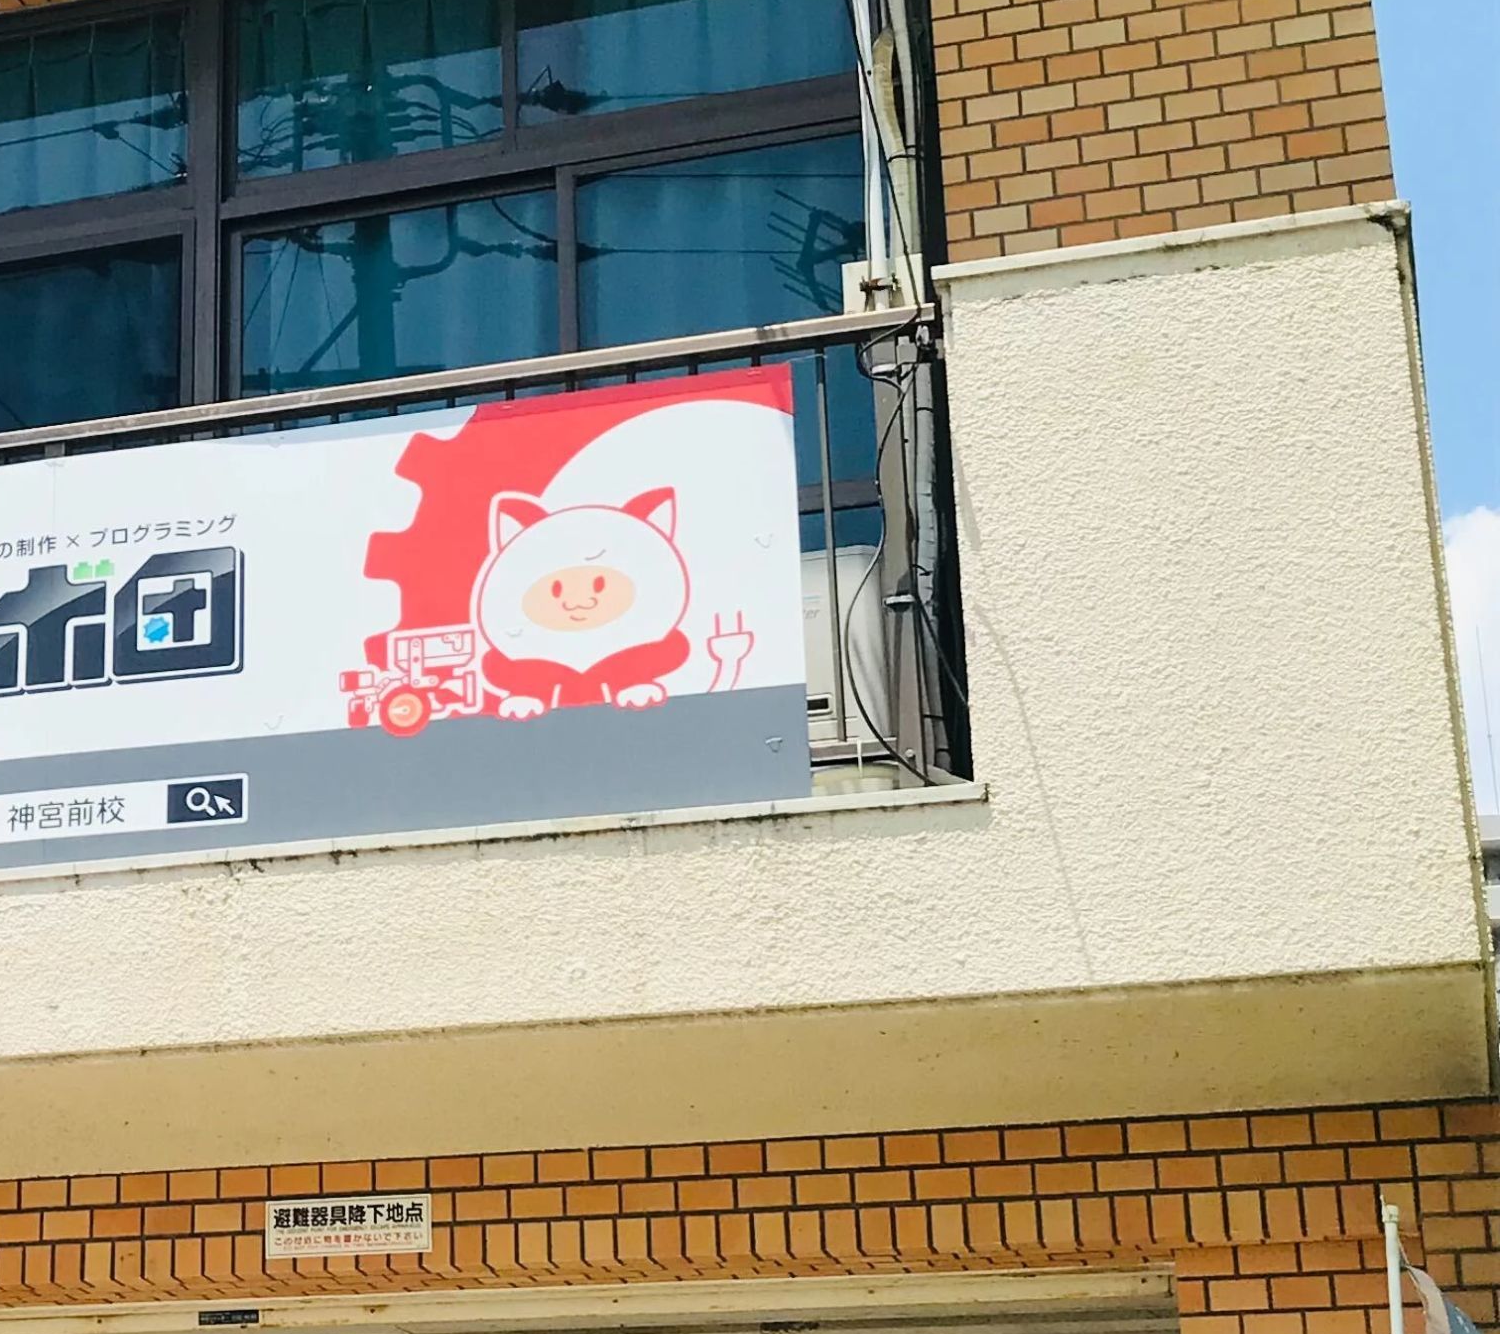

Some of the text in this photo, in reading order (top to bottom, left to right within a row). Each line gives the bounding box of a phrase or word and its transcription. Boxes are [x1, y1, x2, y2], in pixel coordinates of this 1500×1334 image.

[89, 514, 238, 548] プログラミング
[6, 794, 127, 833] 神宮前校
[273, 1201, 425, 1229] 避難器具降下地点
